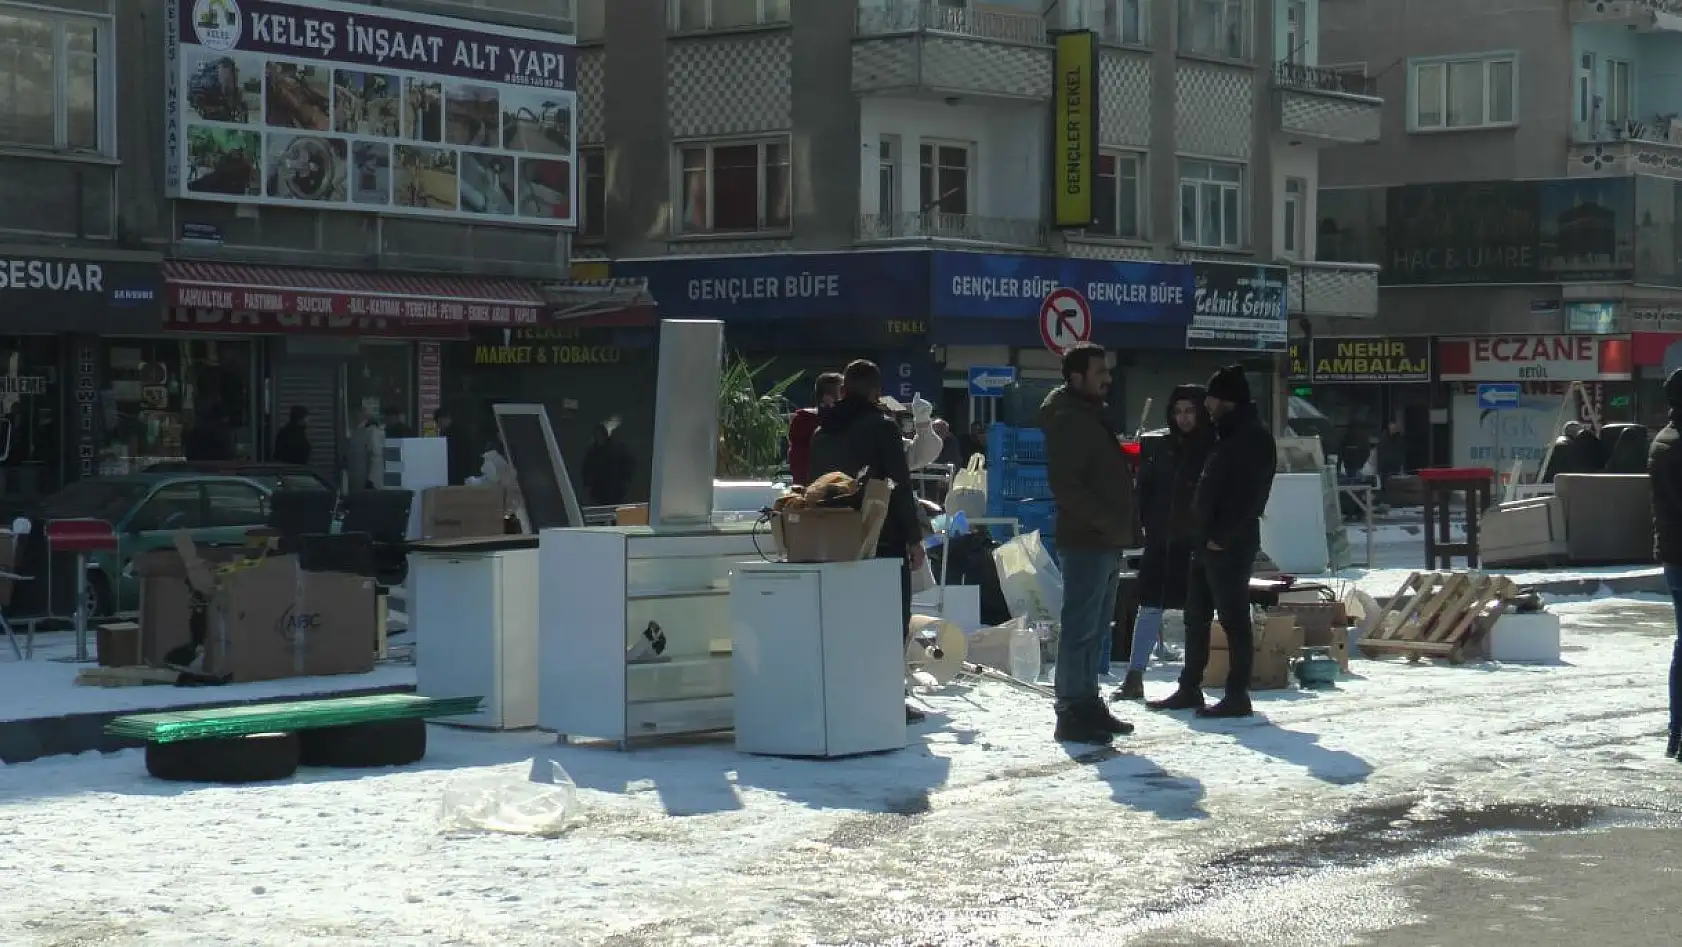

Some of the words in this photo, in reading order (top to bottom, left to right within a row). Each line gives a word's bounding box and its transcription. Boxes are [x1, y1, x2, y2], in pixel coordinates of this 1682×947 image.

[251, 12, 336, 56] KELEŞ
[346, 17, 443, 63] İNŞAAT
[452, 40, 500, 72] ALT
[508, 47, 566, 81] YAPI
[1066, 65, 1081, 116] TEKEL
[1066, 119, 1083, 195] GENÇLER
[1393, 247, 1439, 271] HAC
[1466, 245, 1533, 269] UMRE
[687, 279, 779, 304] GENÇLER
[785, 272, 840, 298] BÜFE
[952, 276, 1019, 301] GENÇLER
[1087, 282, 1147, 305] GENÇLER
[1151, 282, 1184, 305] BÜFE
[296, 295, 333, 313] SUCUK
[1195, 287, 1239, 316] Teknik
[475, 345, 532, 364] MARKET
[538, 346, 548, 364] &
[553, 346, 620, 364] TOBACCO
[1337, 341, 1405, 357] NEHİR
[1474, 336, 1593, 361] ECZANE
[1316, 358, 1427, 373] AMBALAJ
[1518, 363, 1548, 378] BETÜL
